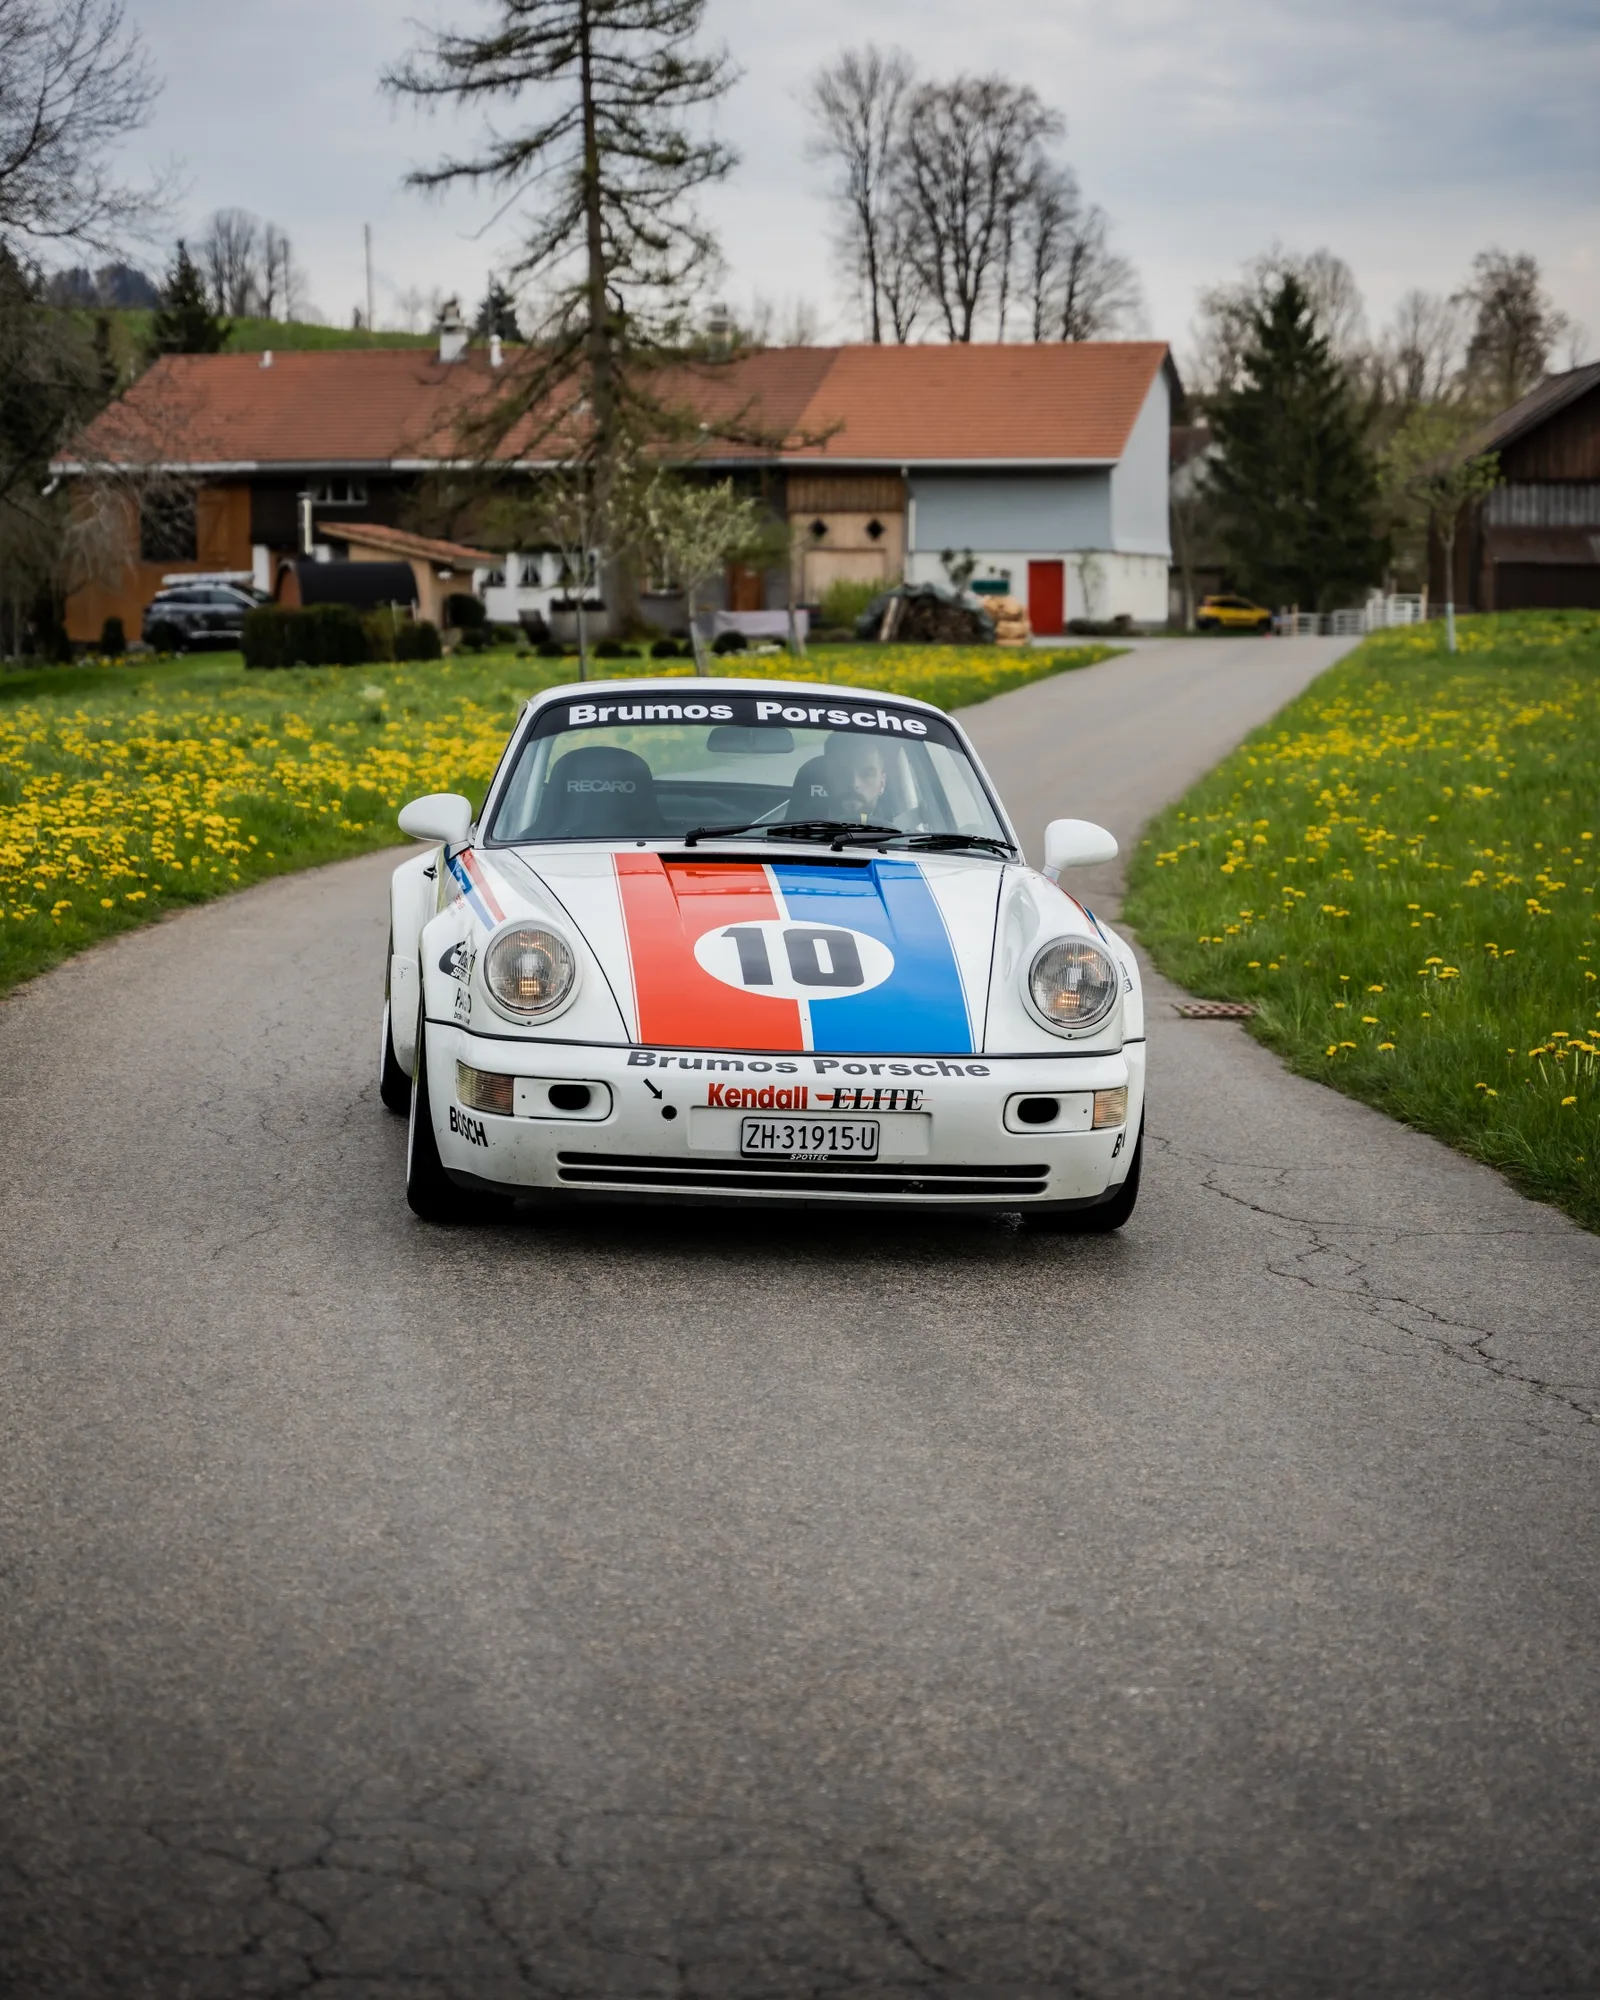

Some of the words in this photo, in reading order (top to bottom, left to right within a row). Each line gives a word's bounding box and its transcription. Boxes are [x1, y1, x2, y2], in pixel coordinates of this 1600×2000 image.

[568, 704, 734, 725] Brumos
[756, 702, 928, 735] Porsche
[567, 780, 636, 793] RECARO
[721, 927, 865, 988] 10
[626, 1051, 799, 1074] Brumos
[813, 1059, 991, 1077] Porsche
[708, 1083, 808, 1110] Kendall
[830, 1087, 924, 1111] ELITE
[449, 1105, 489, 1148] BOSCH
[790, 1153, 829, 1161] SPORTEC
